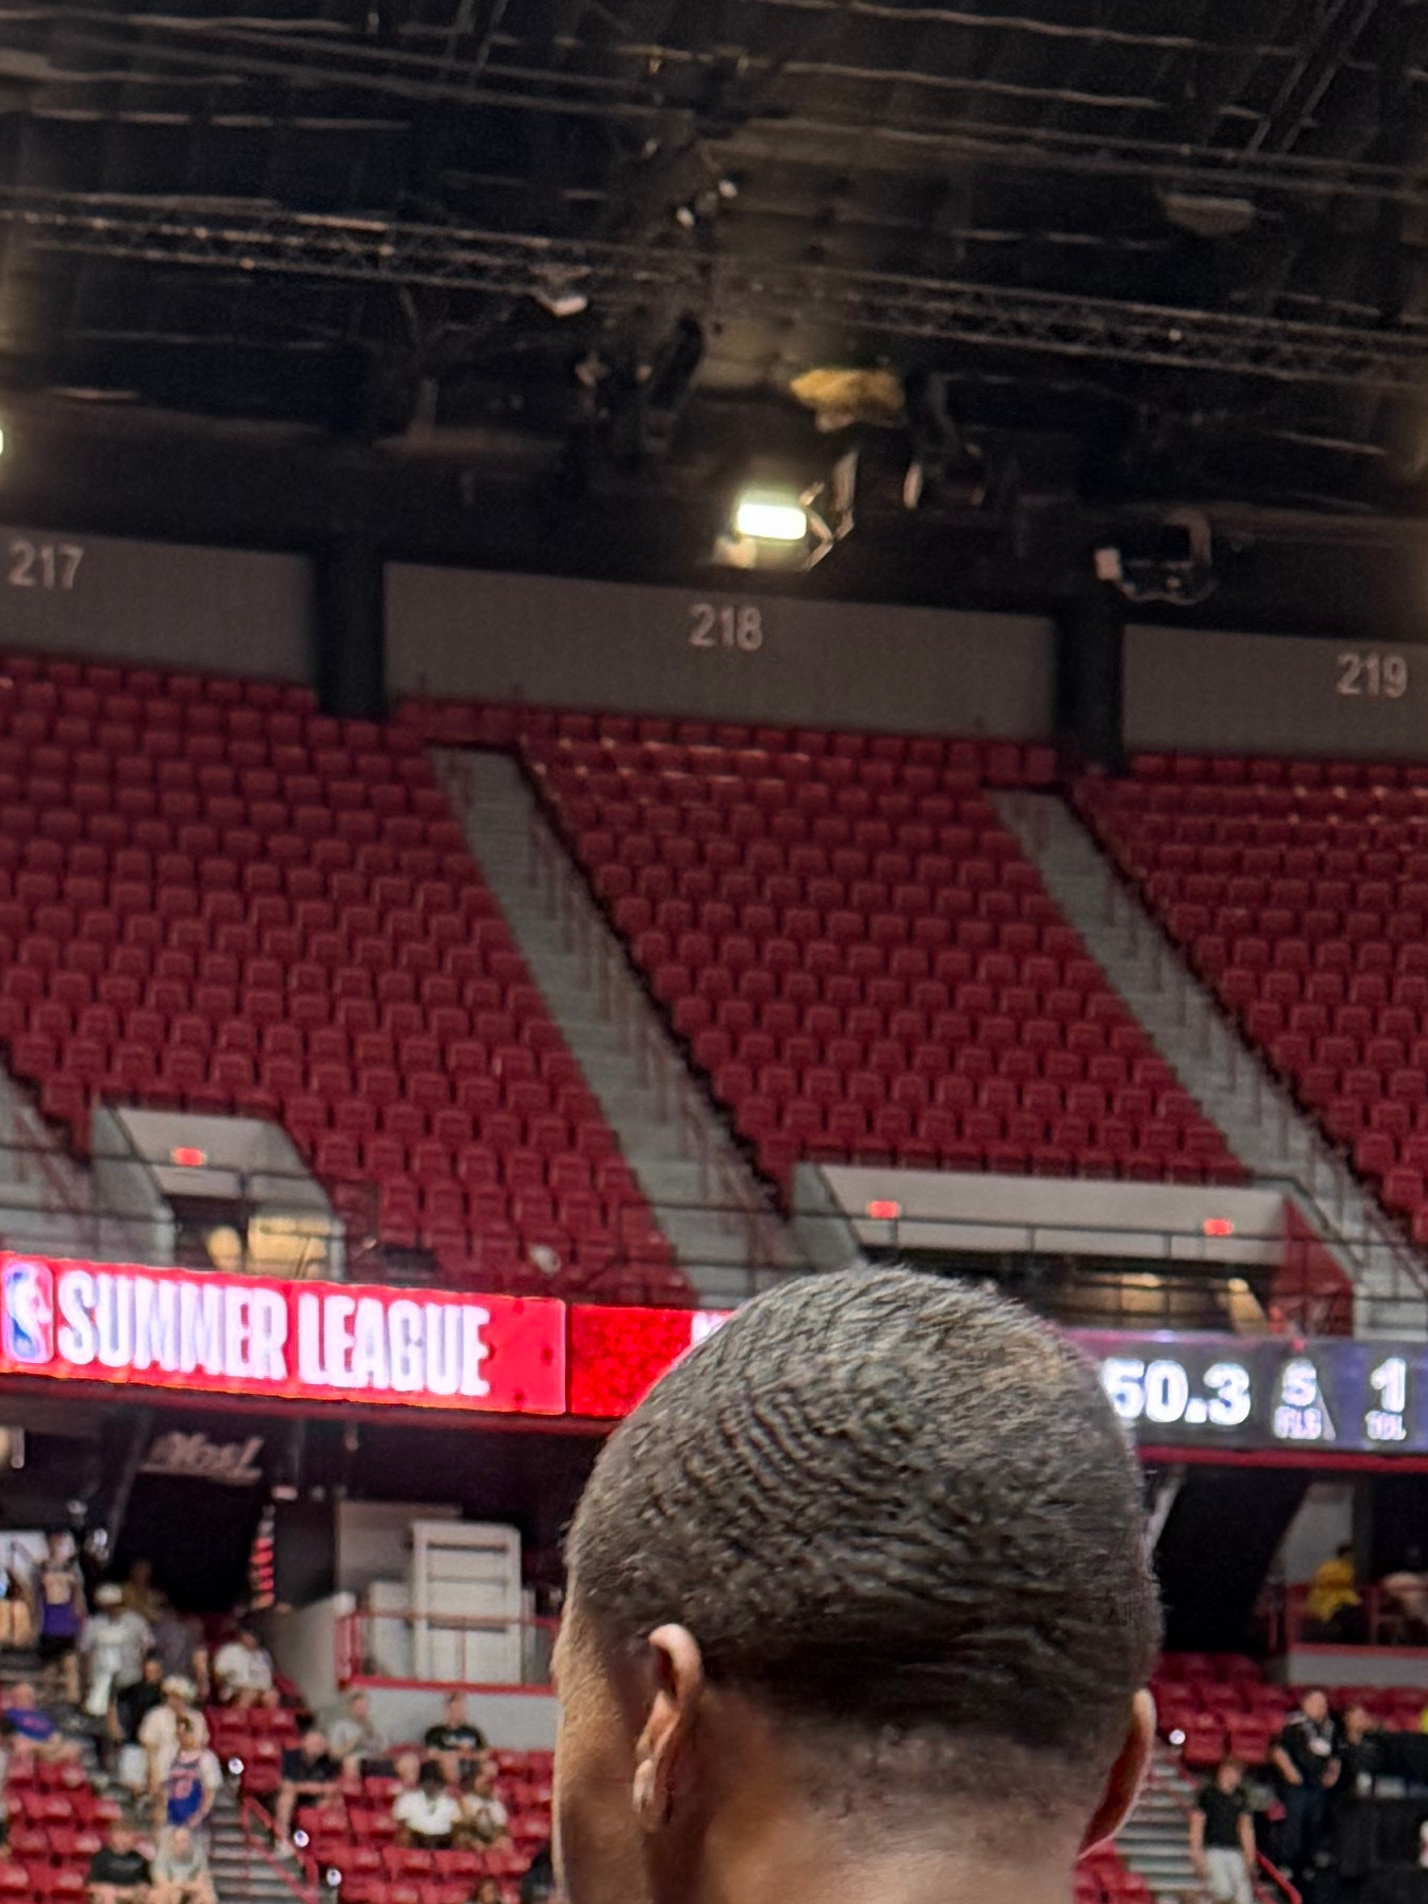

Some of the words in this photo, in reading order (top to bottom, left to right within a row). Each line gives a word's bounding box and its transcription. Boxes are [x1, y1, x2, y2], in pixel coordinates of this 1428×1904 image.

[9, 540, 83, 589] 217
[689, 603, 763, 650] 218
[1337, 653, 1408, 699] 219
[57, 1269, 288, 1382] SUMMER
[298, 1293, 490, 1397] LEAGUE
[1101, 1356, 1251, 1426] 50.3
[1371, 1357, 1407, 1413] 1
